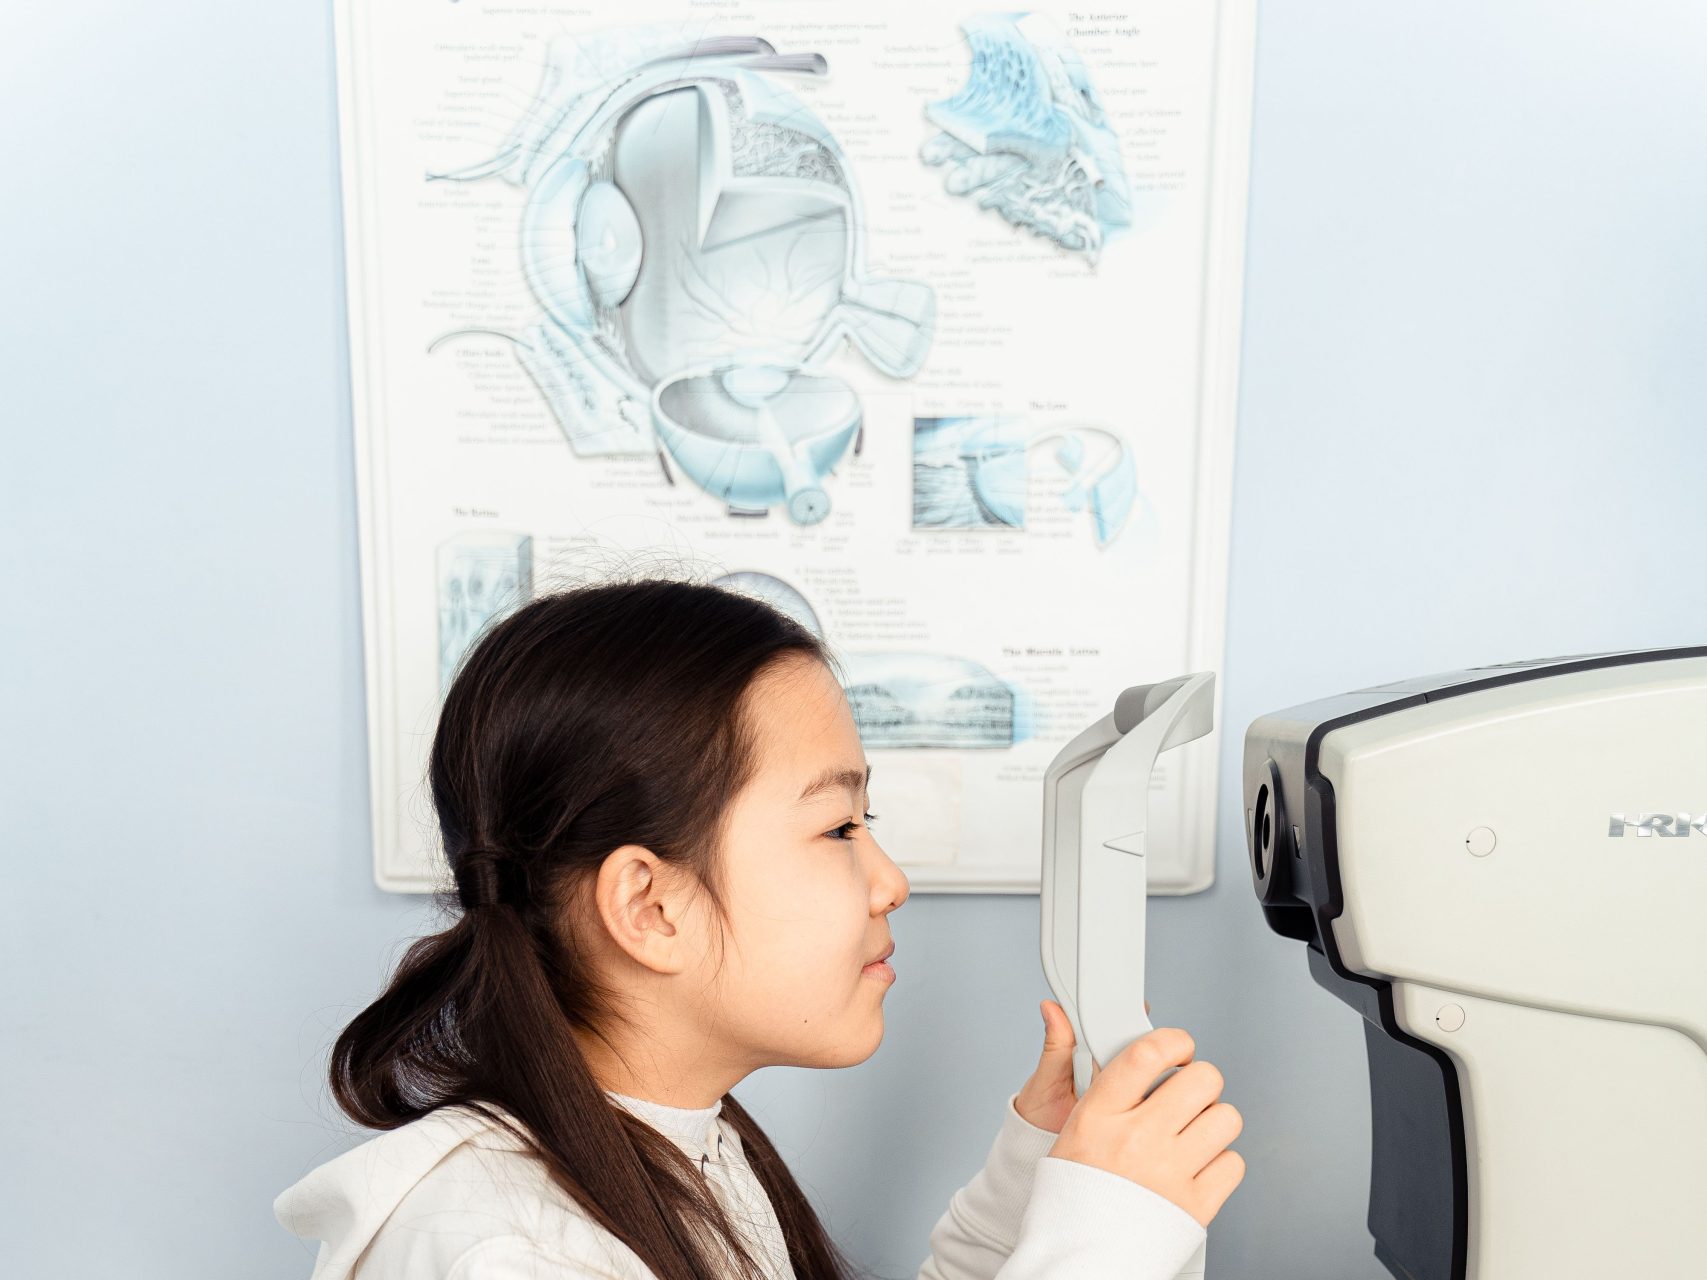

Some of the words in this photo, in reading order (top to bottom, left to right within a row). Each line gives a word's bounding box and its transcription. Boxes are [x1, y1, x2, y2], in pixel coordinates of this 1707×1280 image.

[1068, 12, 1085, 21] The
[1067, 26, 1111, 37] Chamber
[1002, 646, 1021, 656] The
